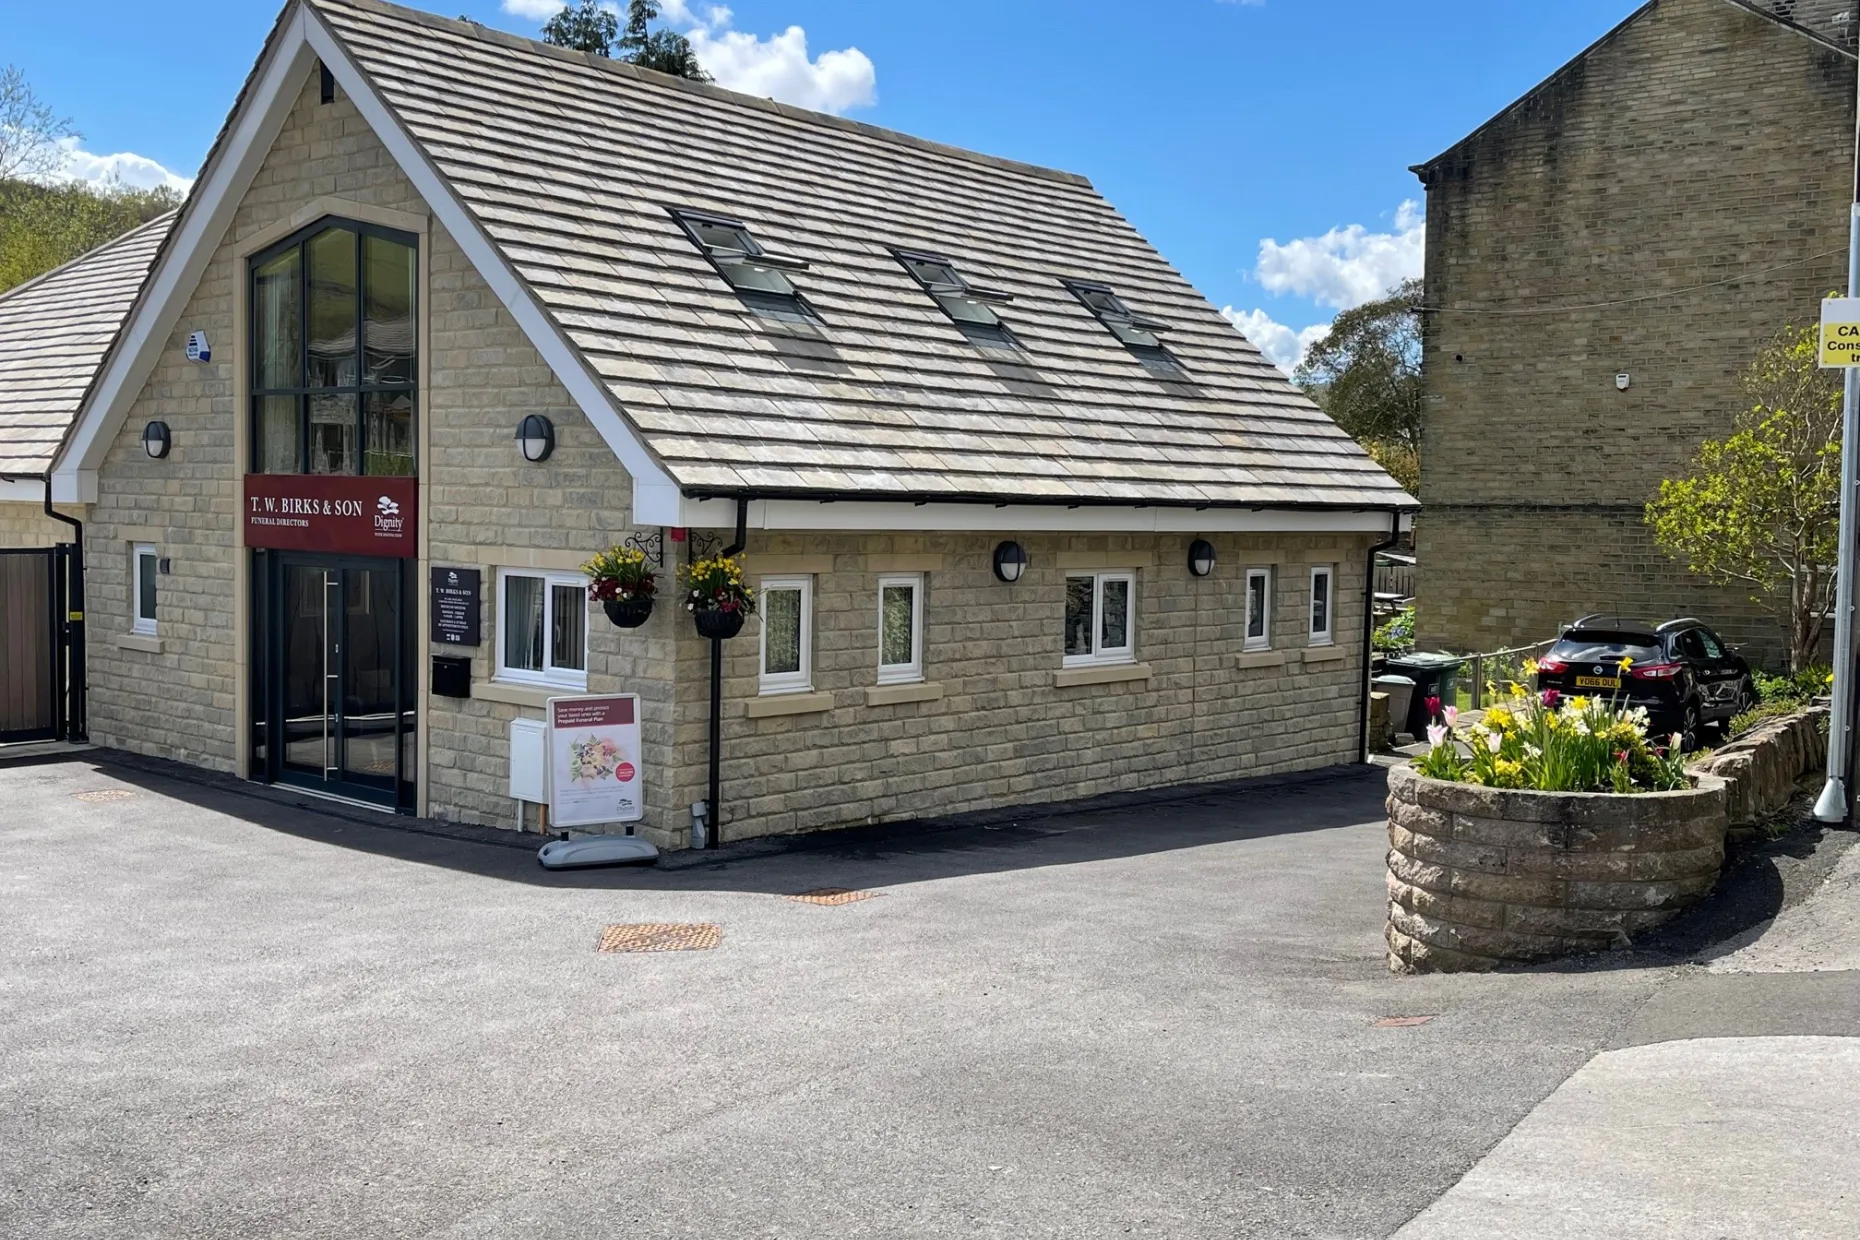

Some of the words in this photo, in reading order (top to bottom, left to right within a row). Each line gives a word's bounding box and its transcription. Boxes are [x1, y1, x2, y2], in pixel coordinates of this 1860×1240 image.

[251, 497, 261, 511] T.
[265, 497, 278, 512] W.
[282, 498, 319, 514] BIRKS
[322, 500, 331, 515] &
[335, 500, 362, 516] SON
[251, 517, 275, 525] FUNERAL
[276, 518, 309, 527] DIRECTORS
[374, 515, 403, 531] Dignity
